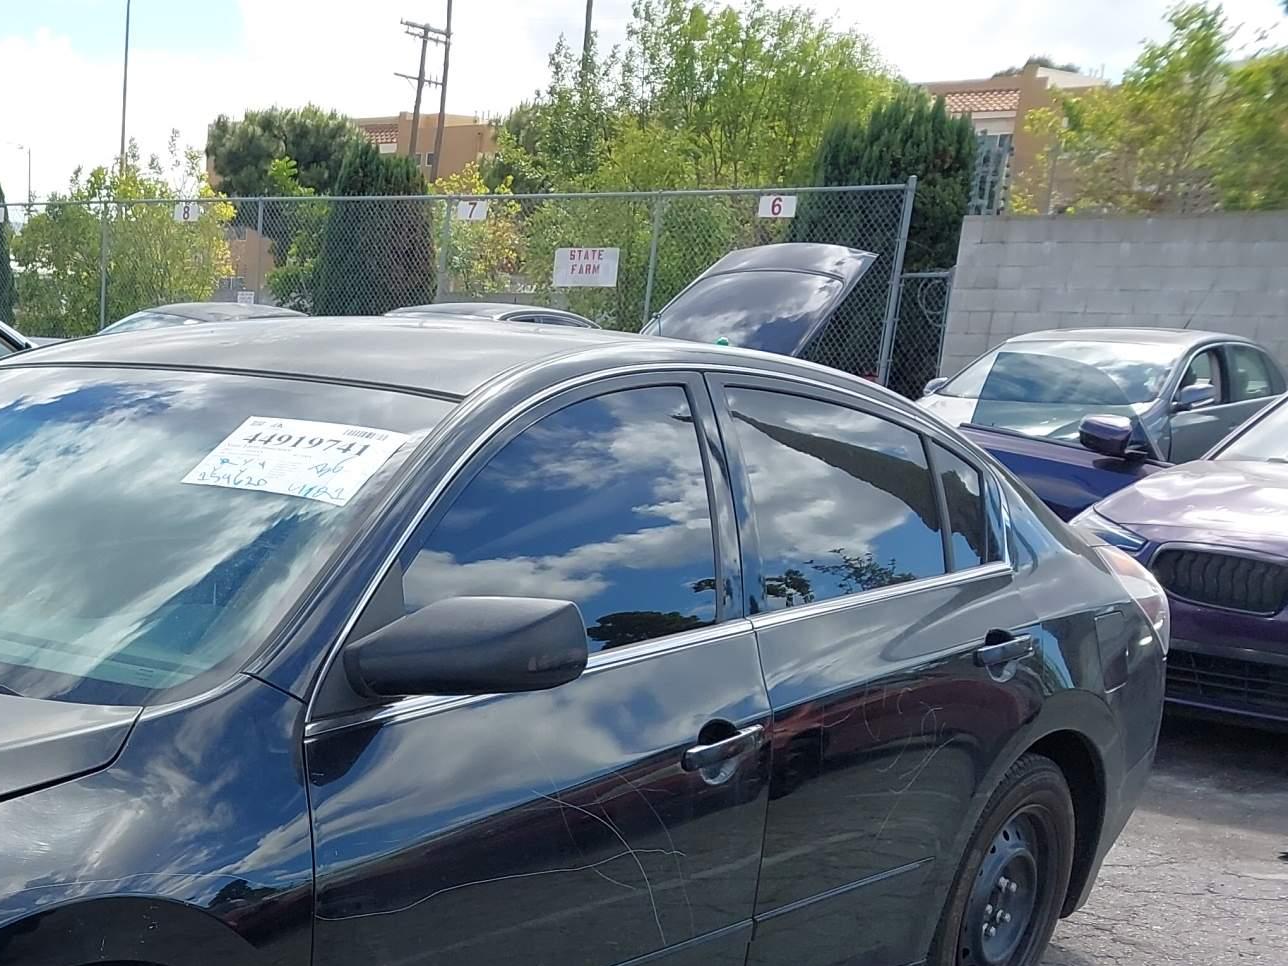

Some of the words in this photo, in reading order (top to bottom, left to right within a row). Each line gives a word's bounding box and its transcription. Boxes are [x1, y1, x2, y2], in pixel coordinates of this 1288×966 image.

[182, 205, 190, 220] 8
[468, 201, 478, 219] 7
[771, 197, 783, 216] 6
[569, 249, 605, 261] STATE
[570, 263, 601, 275] FARM
[242, 432, 370, 457] 44919741
